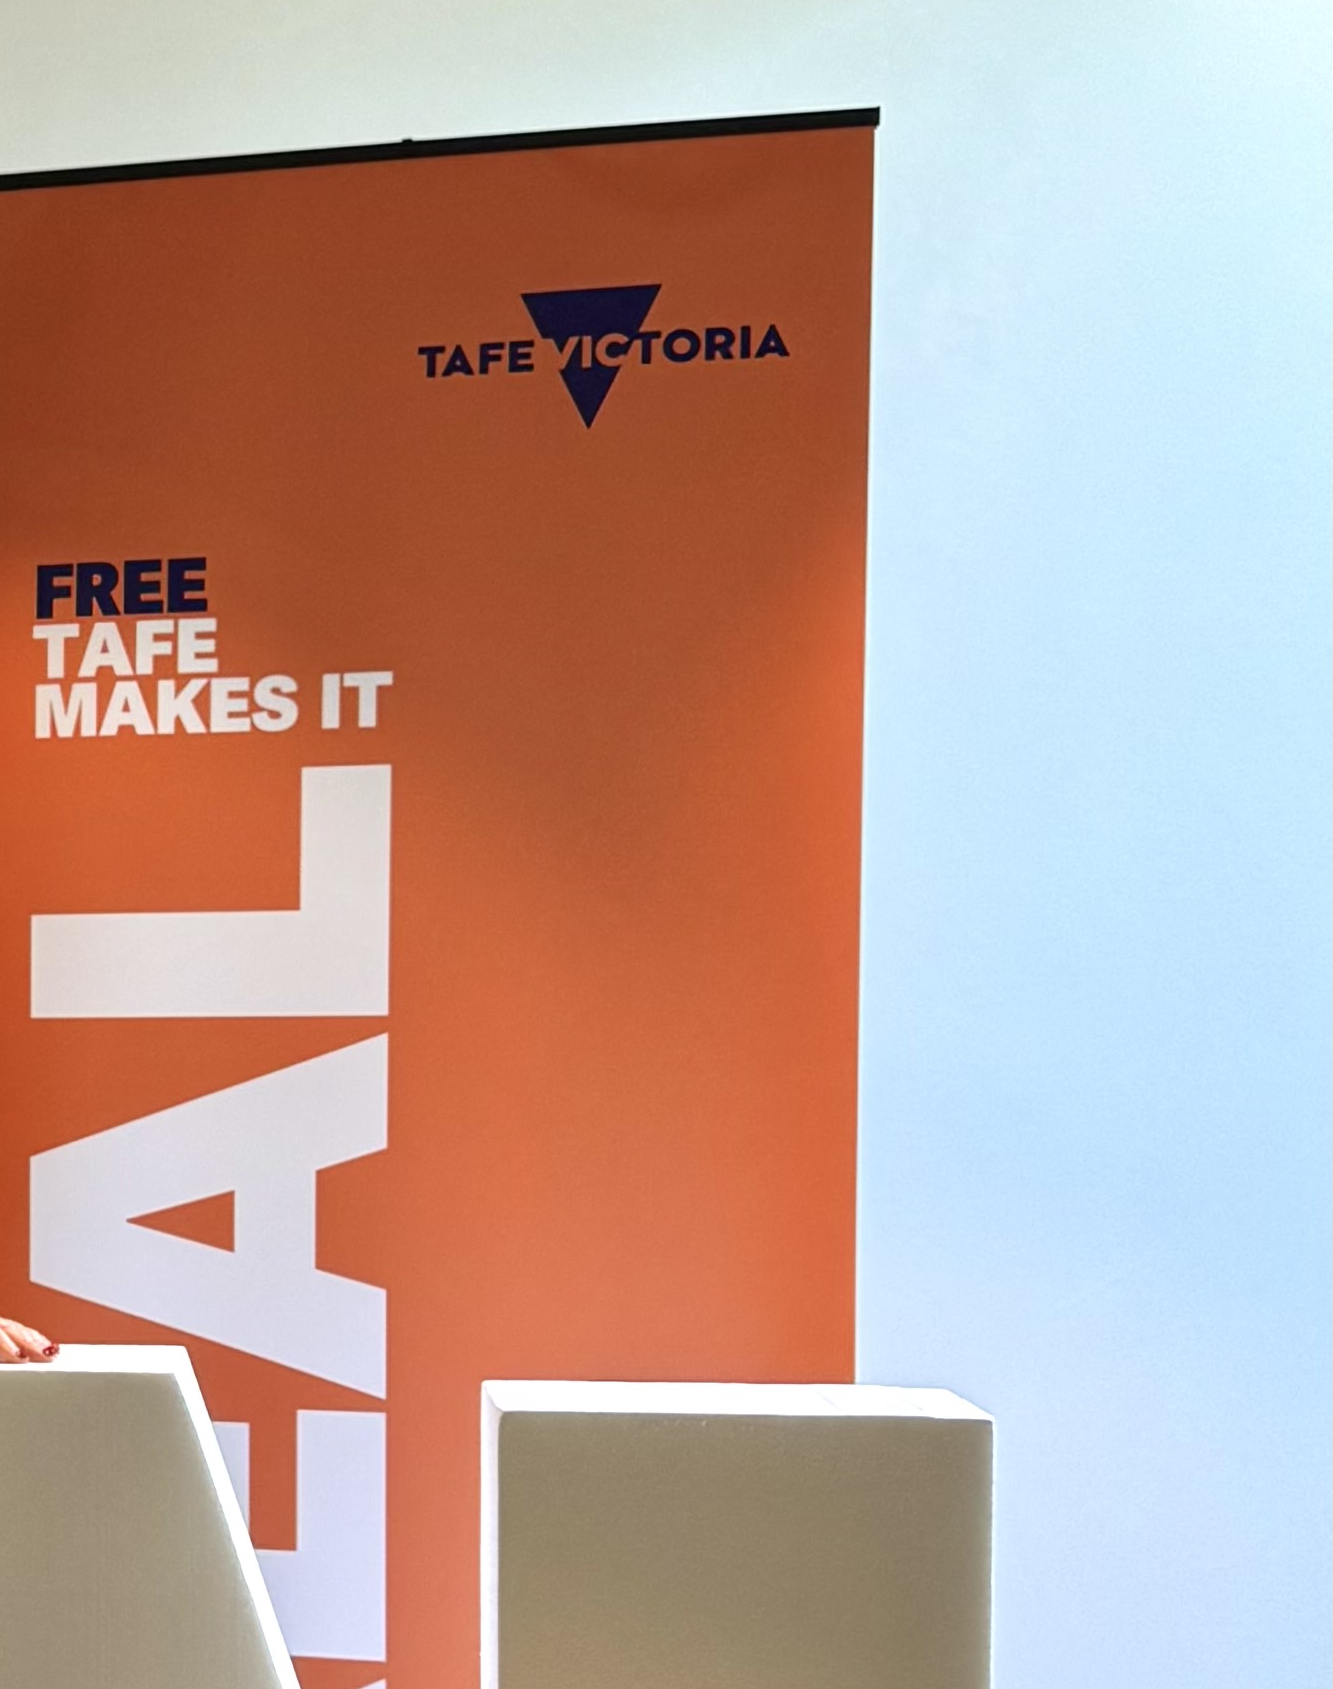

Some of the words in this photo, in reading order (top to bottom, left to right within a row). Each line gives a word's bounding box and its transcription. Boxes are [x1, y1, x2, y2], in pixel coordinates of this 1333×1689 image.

[417, 340, 535, 379] TAFE
[541, 323, 790, 370] VICTORIA
[35, 556, 208, 619] FREE
[32, 617, 219, 680] TAFE
[34, 673, 299, 739] MAKES
[321, 670, 394, 730] IT
